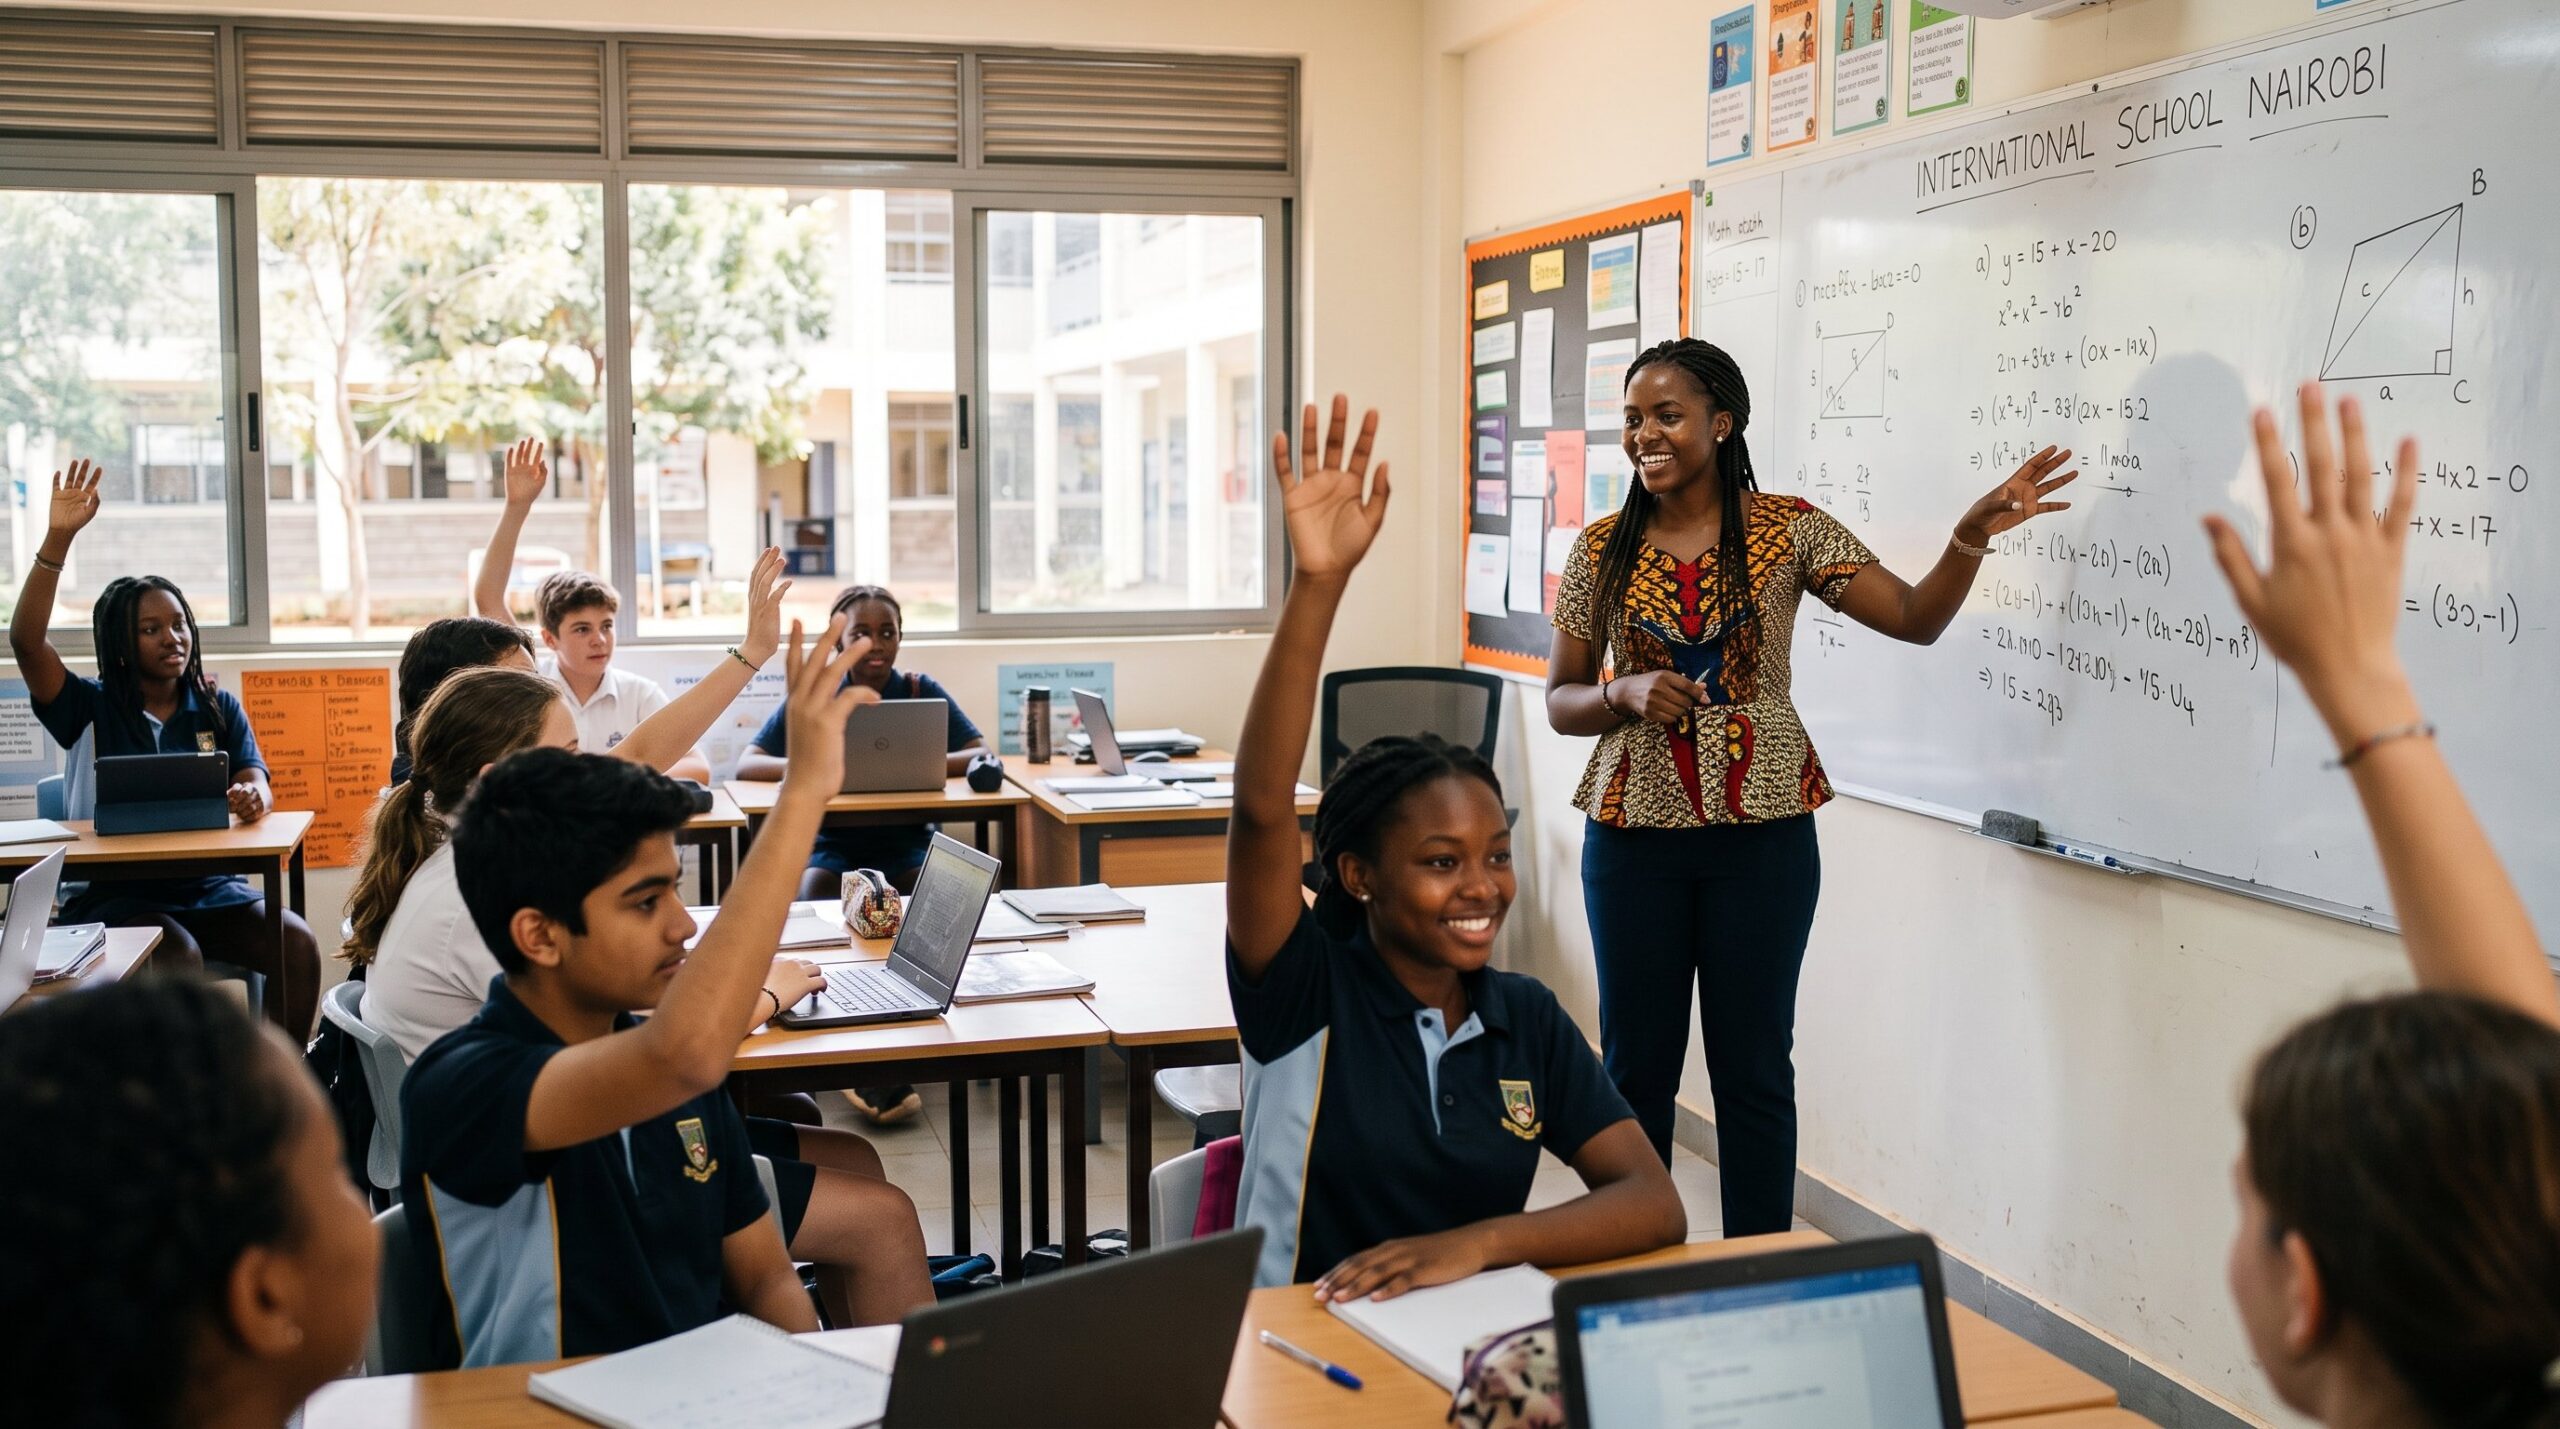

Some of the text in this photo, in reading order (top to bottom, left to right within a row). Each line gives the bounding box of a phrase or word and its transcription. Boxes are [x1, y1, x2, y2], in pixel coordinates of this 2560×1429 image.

[1916, 43, 2387, 198] INTERNATIONAL SCHOOL NAIROBI
[2472, 168, 2487, 196] B
[2463, 277, 2474, 306] h
[1887, 312, 1894, 329] D
[2453, 379, 2471, 404] C
